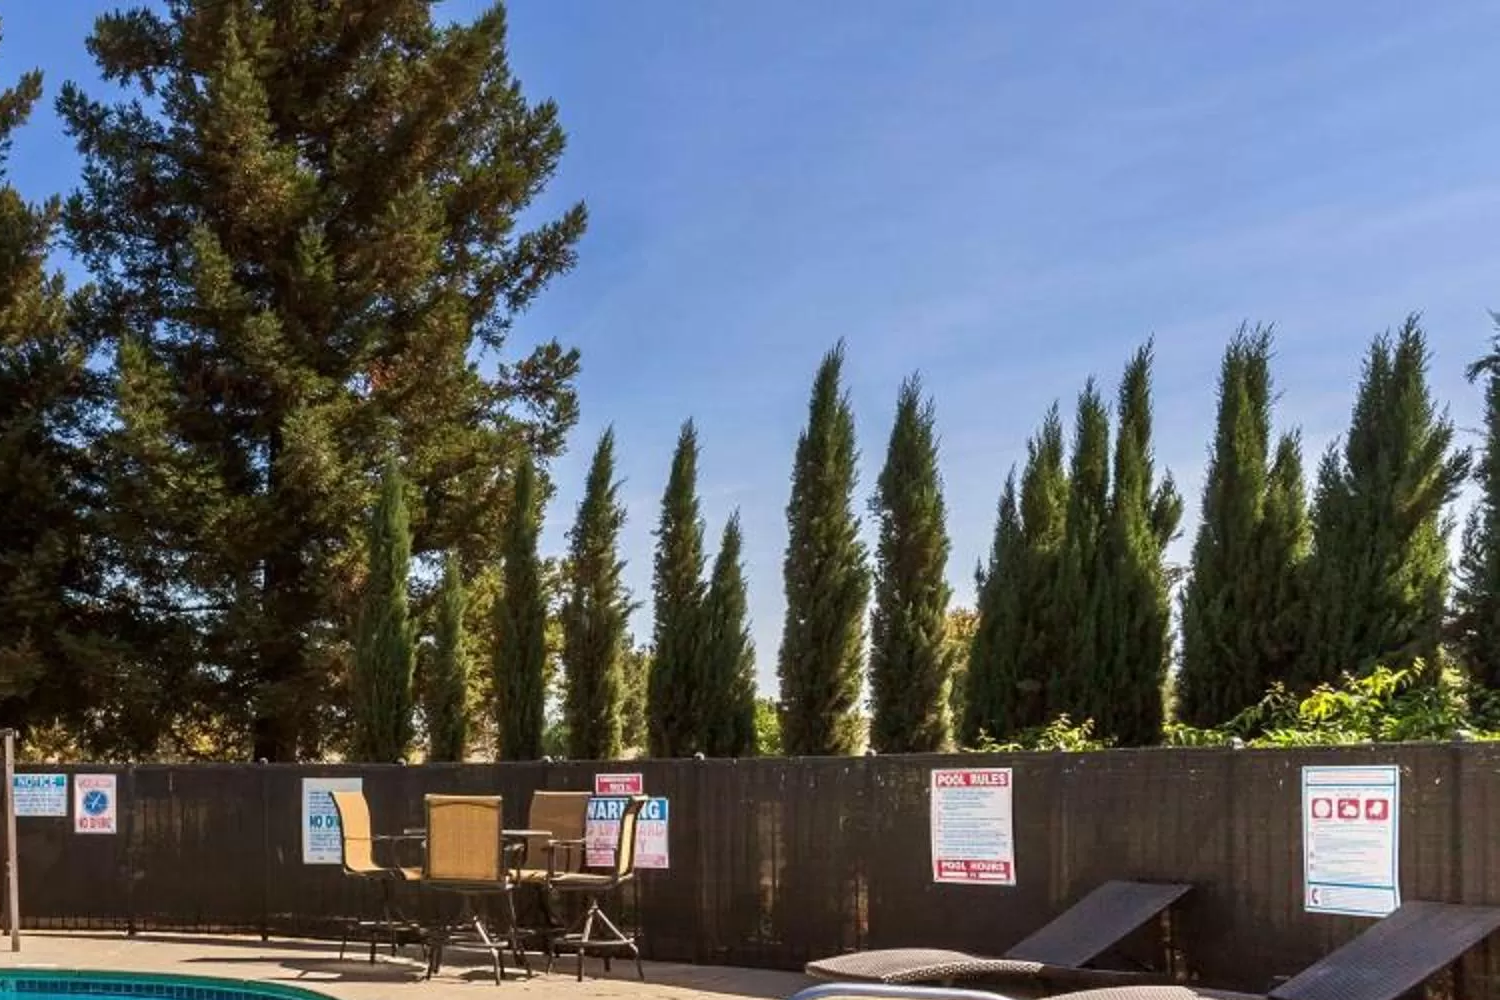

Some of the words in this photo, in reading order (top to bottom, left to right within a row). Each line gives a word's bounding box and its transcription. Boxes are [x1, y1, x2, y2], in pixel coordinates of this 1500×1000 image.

[938, 773, 966, 785] POOL
[971, 773, 1006, 785] RULES
[587, 801, 660, 819] WARNG
[941, 861, 966, 871] POOL
